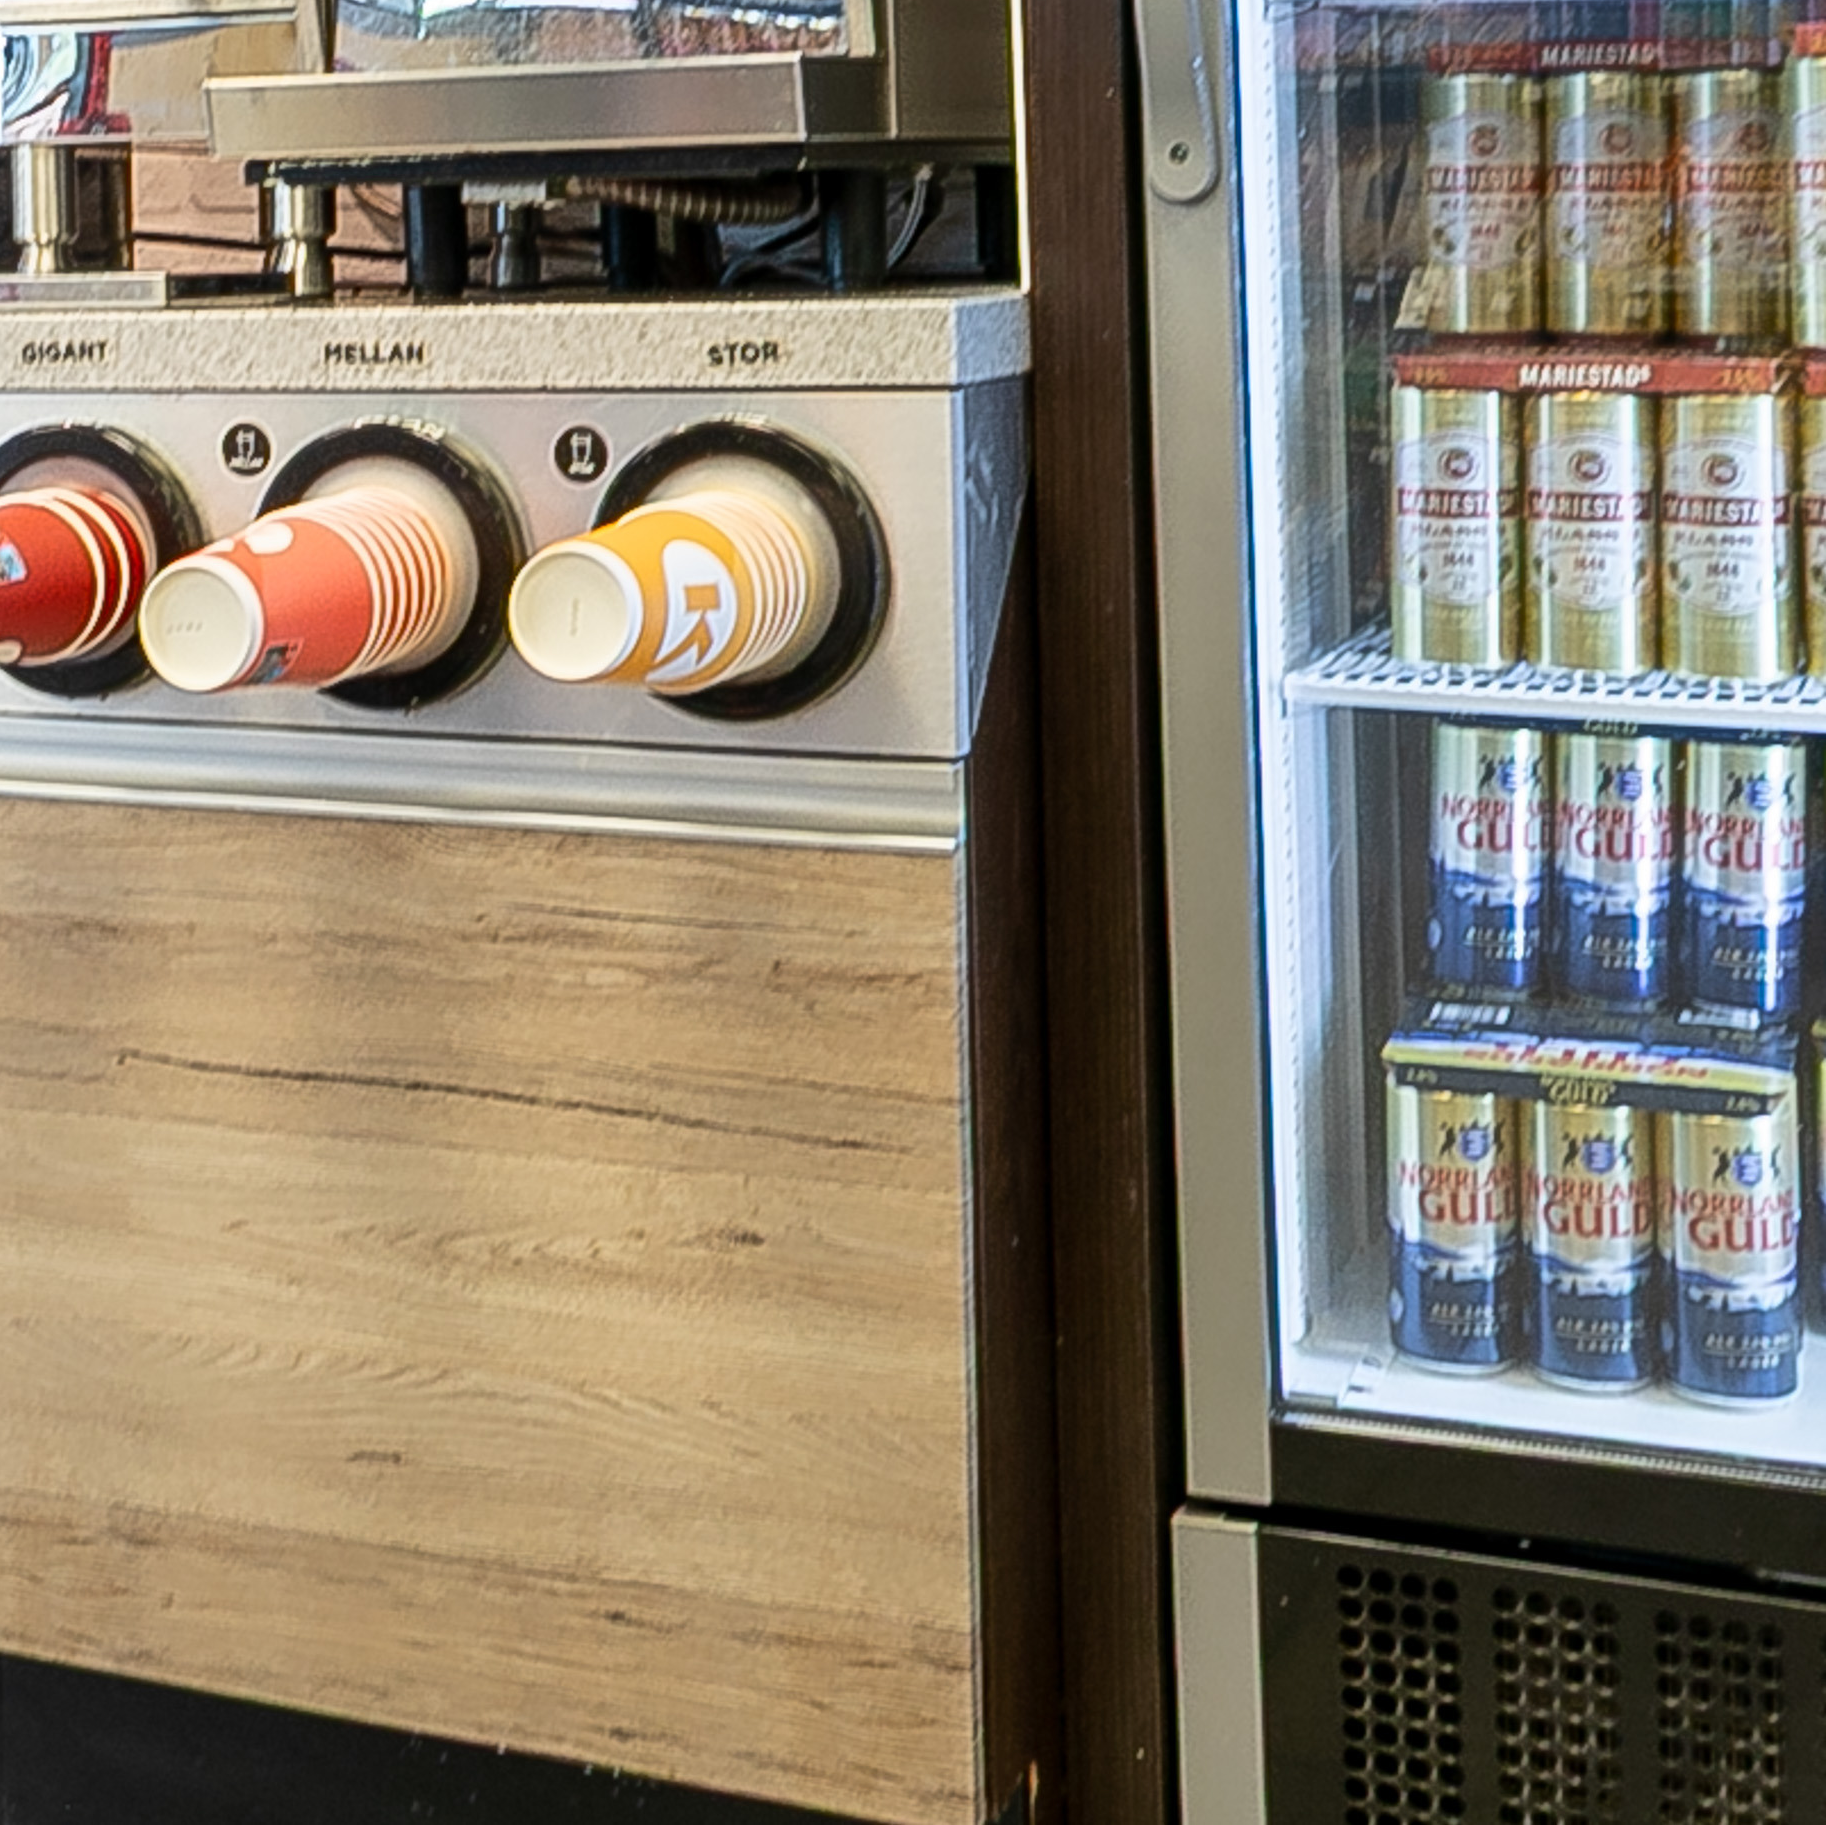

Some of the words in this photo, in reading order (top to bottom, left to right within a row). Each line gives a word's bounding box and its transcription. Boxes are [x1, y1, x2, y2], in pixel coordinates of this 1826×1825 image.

[21, 340, 109, 367] GIGANT
[324, 341, 425, 367] MELLAN
[706, 341, 781, 367] STOR
[1543, 1198, 1651, 1239] GULD
[1688, 1211, 1796, 1252] GULD
